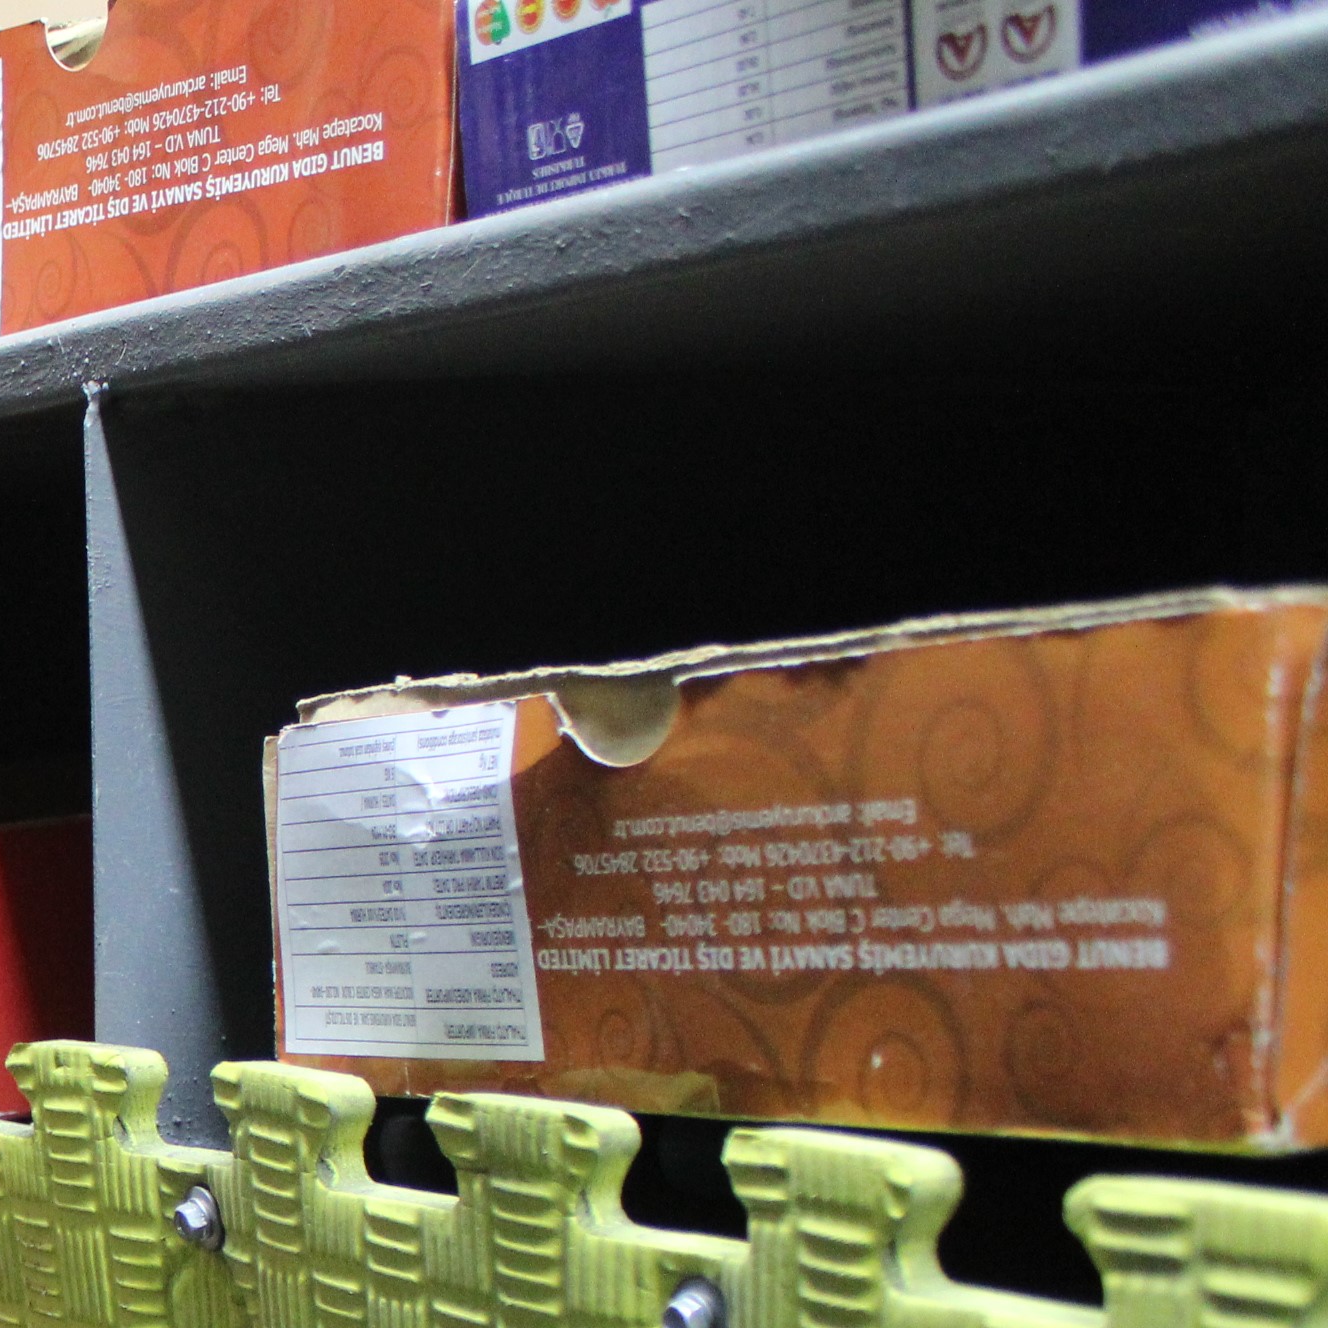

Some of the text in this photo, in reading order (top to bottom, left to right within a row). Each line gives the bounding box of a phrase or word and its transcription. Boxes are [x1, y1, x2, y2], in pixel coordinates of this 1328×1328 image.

[65, 65, 247, 128] Email: arckuruyemis@benut.com.tr
[37, 83, 281, 161] Tel: +90-212-4370426 Mob: +90-532 2845706
[322, 112, 383, 140] Kocatepe
[165, 133, 184, 153] V.D
[186, 125, 221, 146] TUNA
[258, 134, 289, 156] Mega
[293, 126, 319, 149] Mah.
[111, 146, 129, 166] 043
[132, 141, 151, 159] 164
[202, 153, 211, 171] C
[215, 143, 254, 164] Center
[330, 141, 384, 169] BENUT
[86, 152, 108, 173] 7646
[151, 161, 170, 179] No:
[174, 156, 198, 177] Blok
[292, 153, 328, 178] GIDA
[87, 172, 121, 196] 34040-
[124, 167, 147, 188] 180-
[206, 162, 289, 200] KURUYEMİŞ
[107, 196, 129, 218] DIŞ
[132, 194, 148, 213] VE
[150, 181, 203, 213] SANAYİ
[55, 203, 105, 225] TİCARET
[2, 214, 53, 240] LİMİTED
[573, 851, 639, 876] 2845706
[643, 848, 712, 872] +90-532
[652, 881, 694, 905] 7646
[697, 880, 730, 904] 043
[732, 877, 765, 902] 164
[822, 873, 877, 899] TUNA
[803, 909, 846, 934] Blok
[847, 907, 866, 934] C
[537, 948, 610, 976] LİMİTED
[614, 948, 693, 976] TİCARET
[696, 942, 734, 971] DIŞ
[738, 946, 765, 970] VE
[770, 944, 854, 976] SANAYİ
[1077, 938, 1169, 970] BENUT
